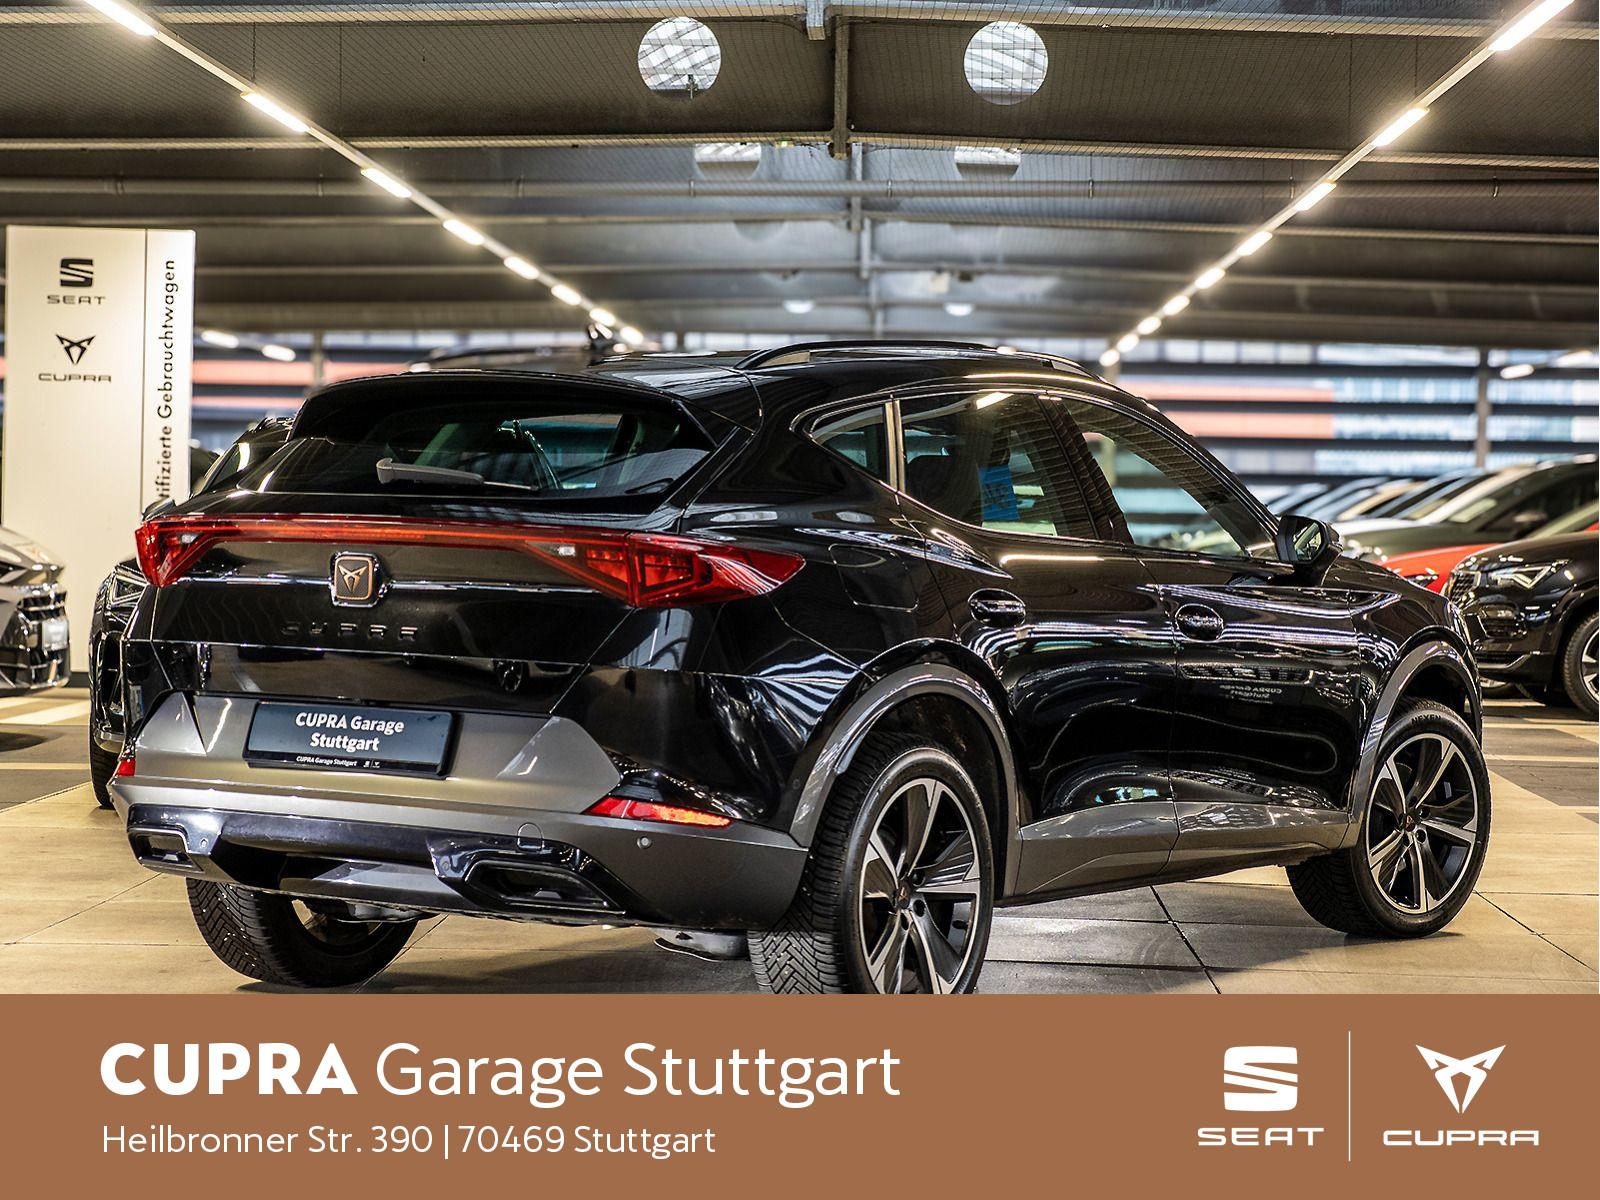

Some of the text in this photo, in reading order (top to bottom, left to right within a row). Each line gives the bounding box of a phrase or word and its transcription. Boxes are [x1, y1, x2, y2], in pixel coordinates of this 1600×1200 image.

[47, 295, 106, 305] SEAT
[38, 373, 112, 382] CUPRA
[155, 260, 178, 499] tifizierte Gebrauchtwagen
[296, 713, 404, 735] CUPRA Garage
[310, 733, 379, 752] Stuttgart
[315, 757, 333, 765] Garage
[333, 758, 358, 767] Stuttgart
